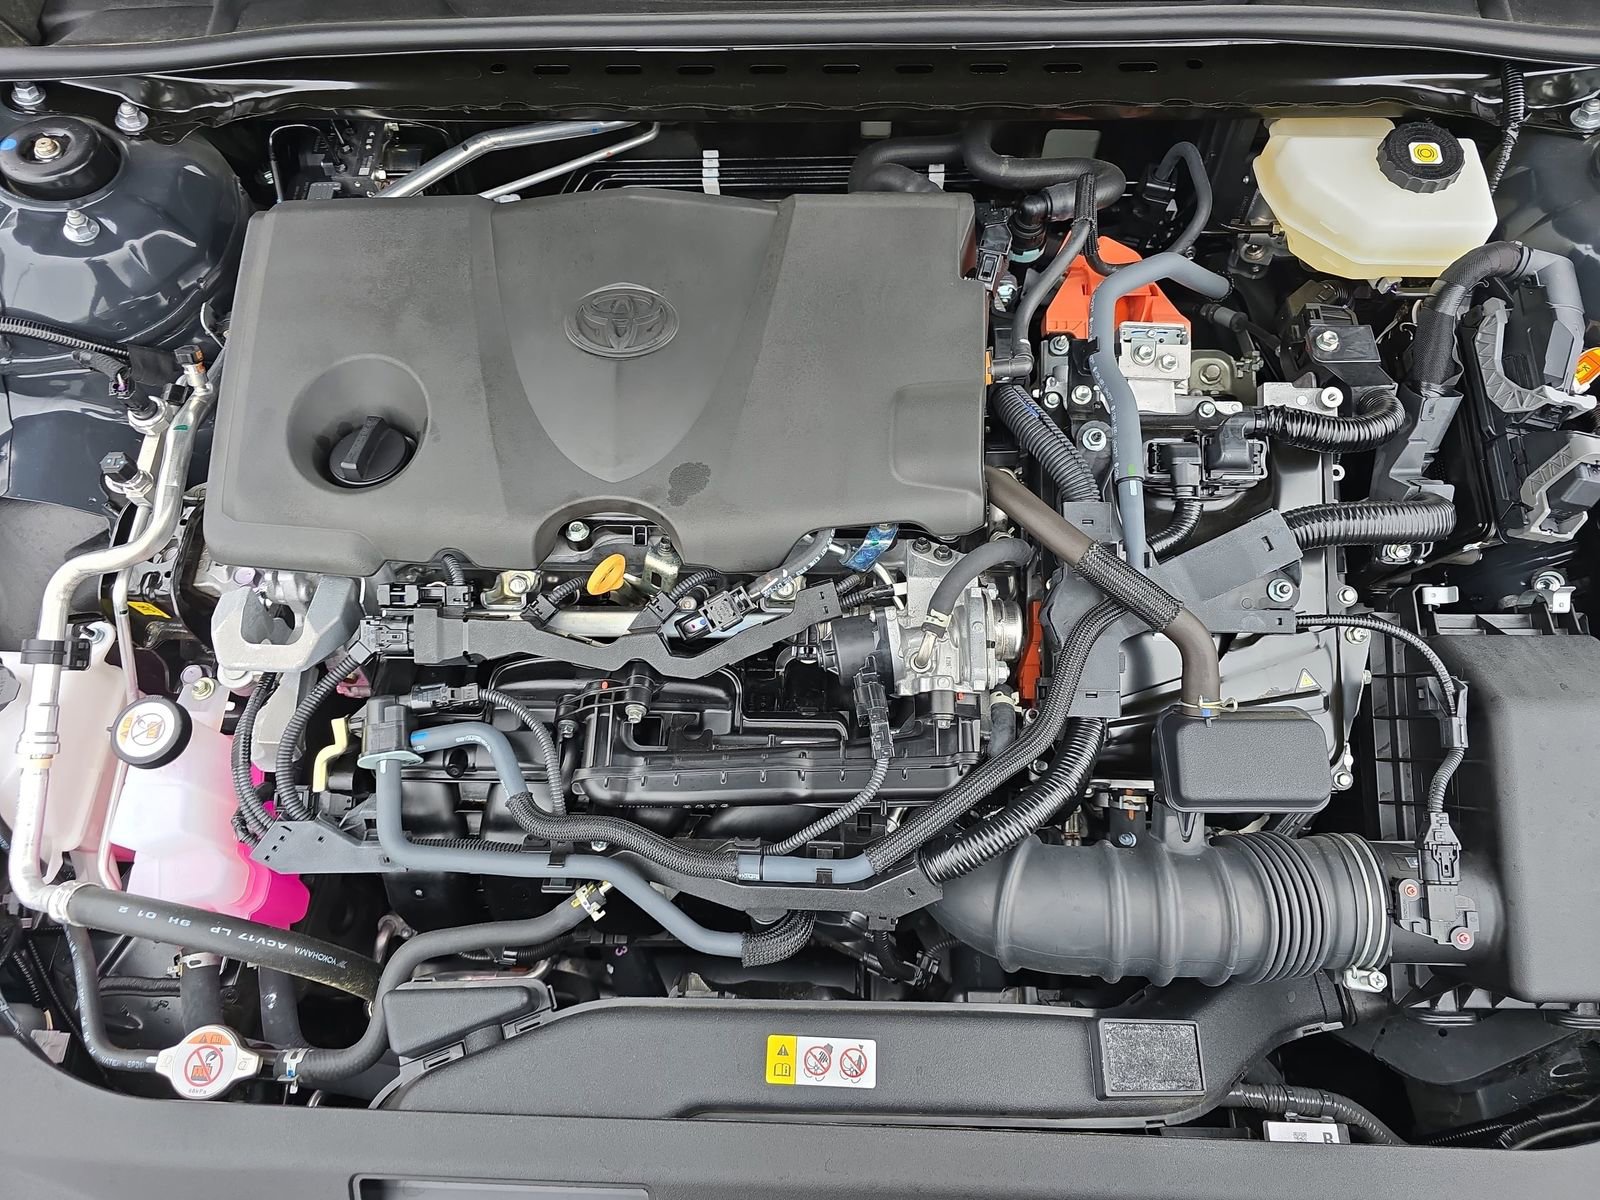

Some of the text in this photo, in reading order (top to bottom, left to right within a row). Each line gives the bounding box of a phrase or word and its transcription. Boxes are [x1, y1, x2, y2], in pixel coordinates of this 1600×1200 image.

[118, 905, 127, 913] 2
[210, 926, 232, 935] LP
[238, 933, 287, 949] ACV17
[294, 944, 337, 966] YOKOHAMA
